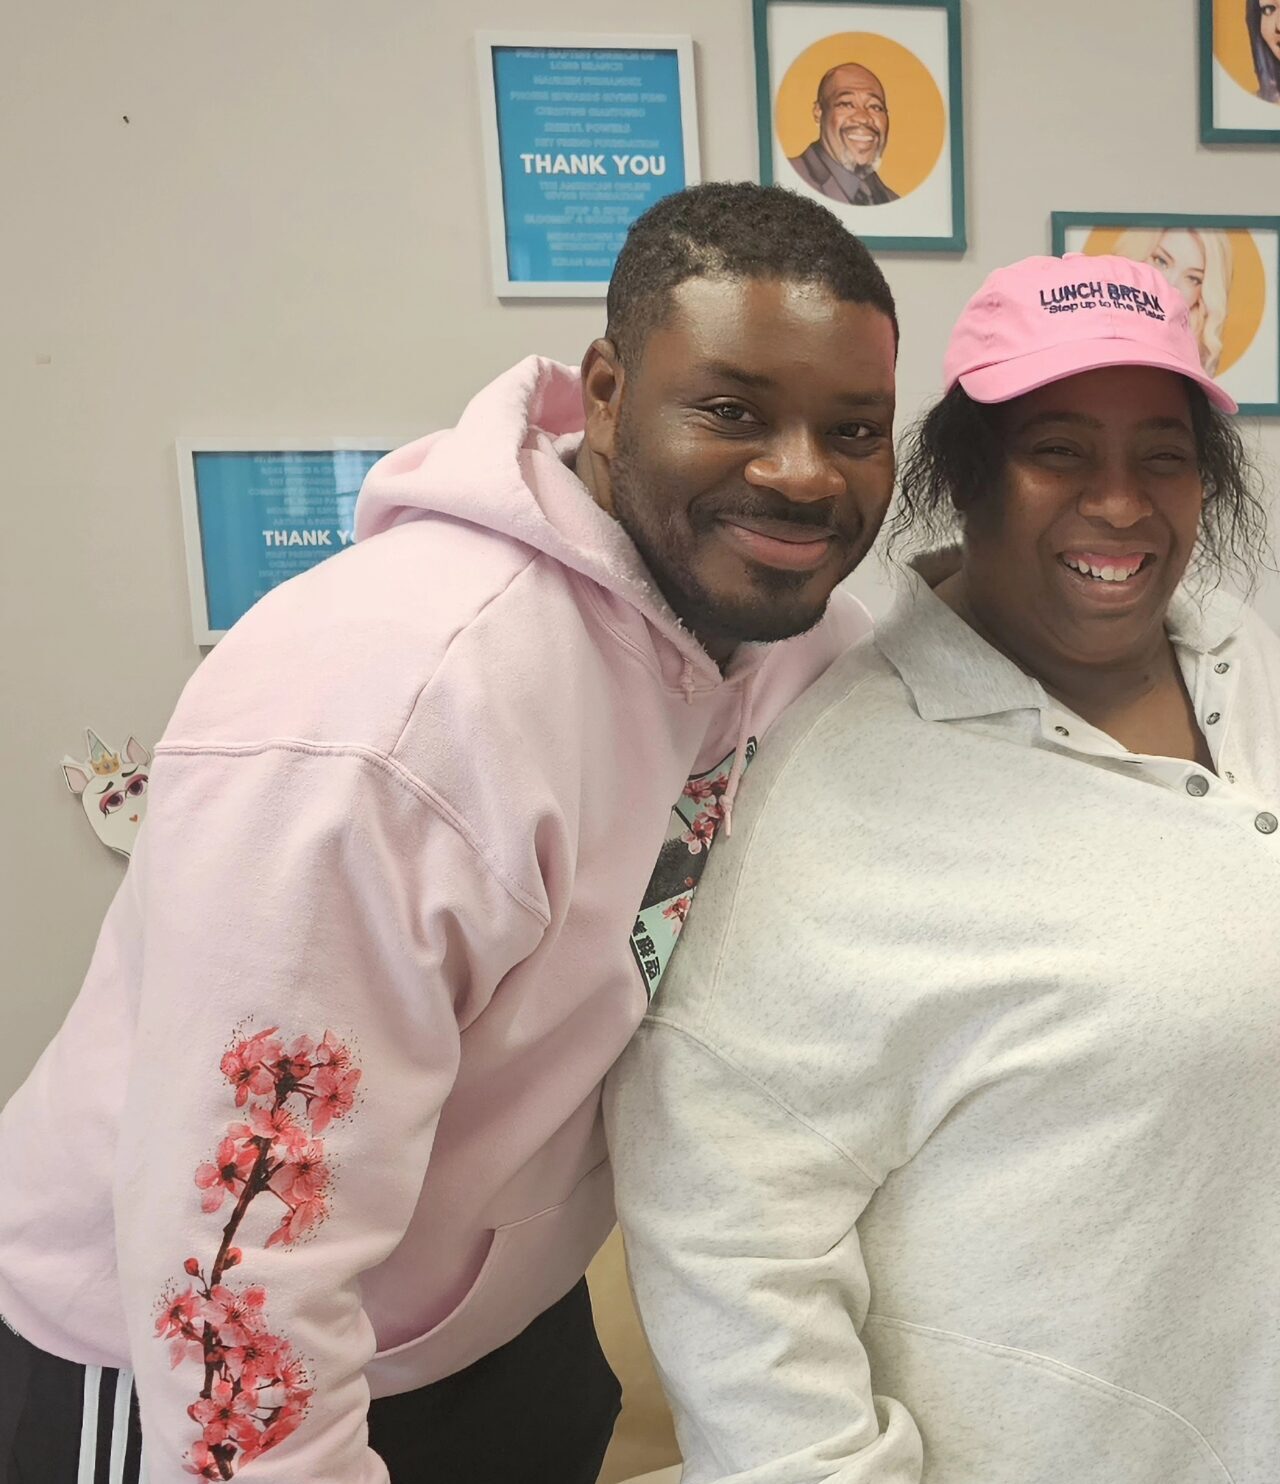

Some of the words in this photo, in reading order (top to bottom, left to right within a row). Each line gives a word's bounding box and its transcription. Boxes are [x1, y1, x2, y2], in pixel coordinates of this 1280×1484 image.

[520, 153, 606, 175] THANK
[612, 155, 666, 175] YOU
[1040, 281, 1104, 307] LUNCH
[1107, 283, 1165, 314] BREAK
[1080, 300, 1097, 312] up
[1100, 299, 1111, 308] to
[1114, 300, 1134, 312] the
[262, 530, 332, 546] THANK
